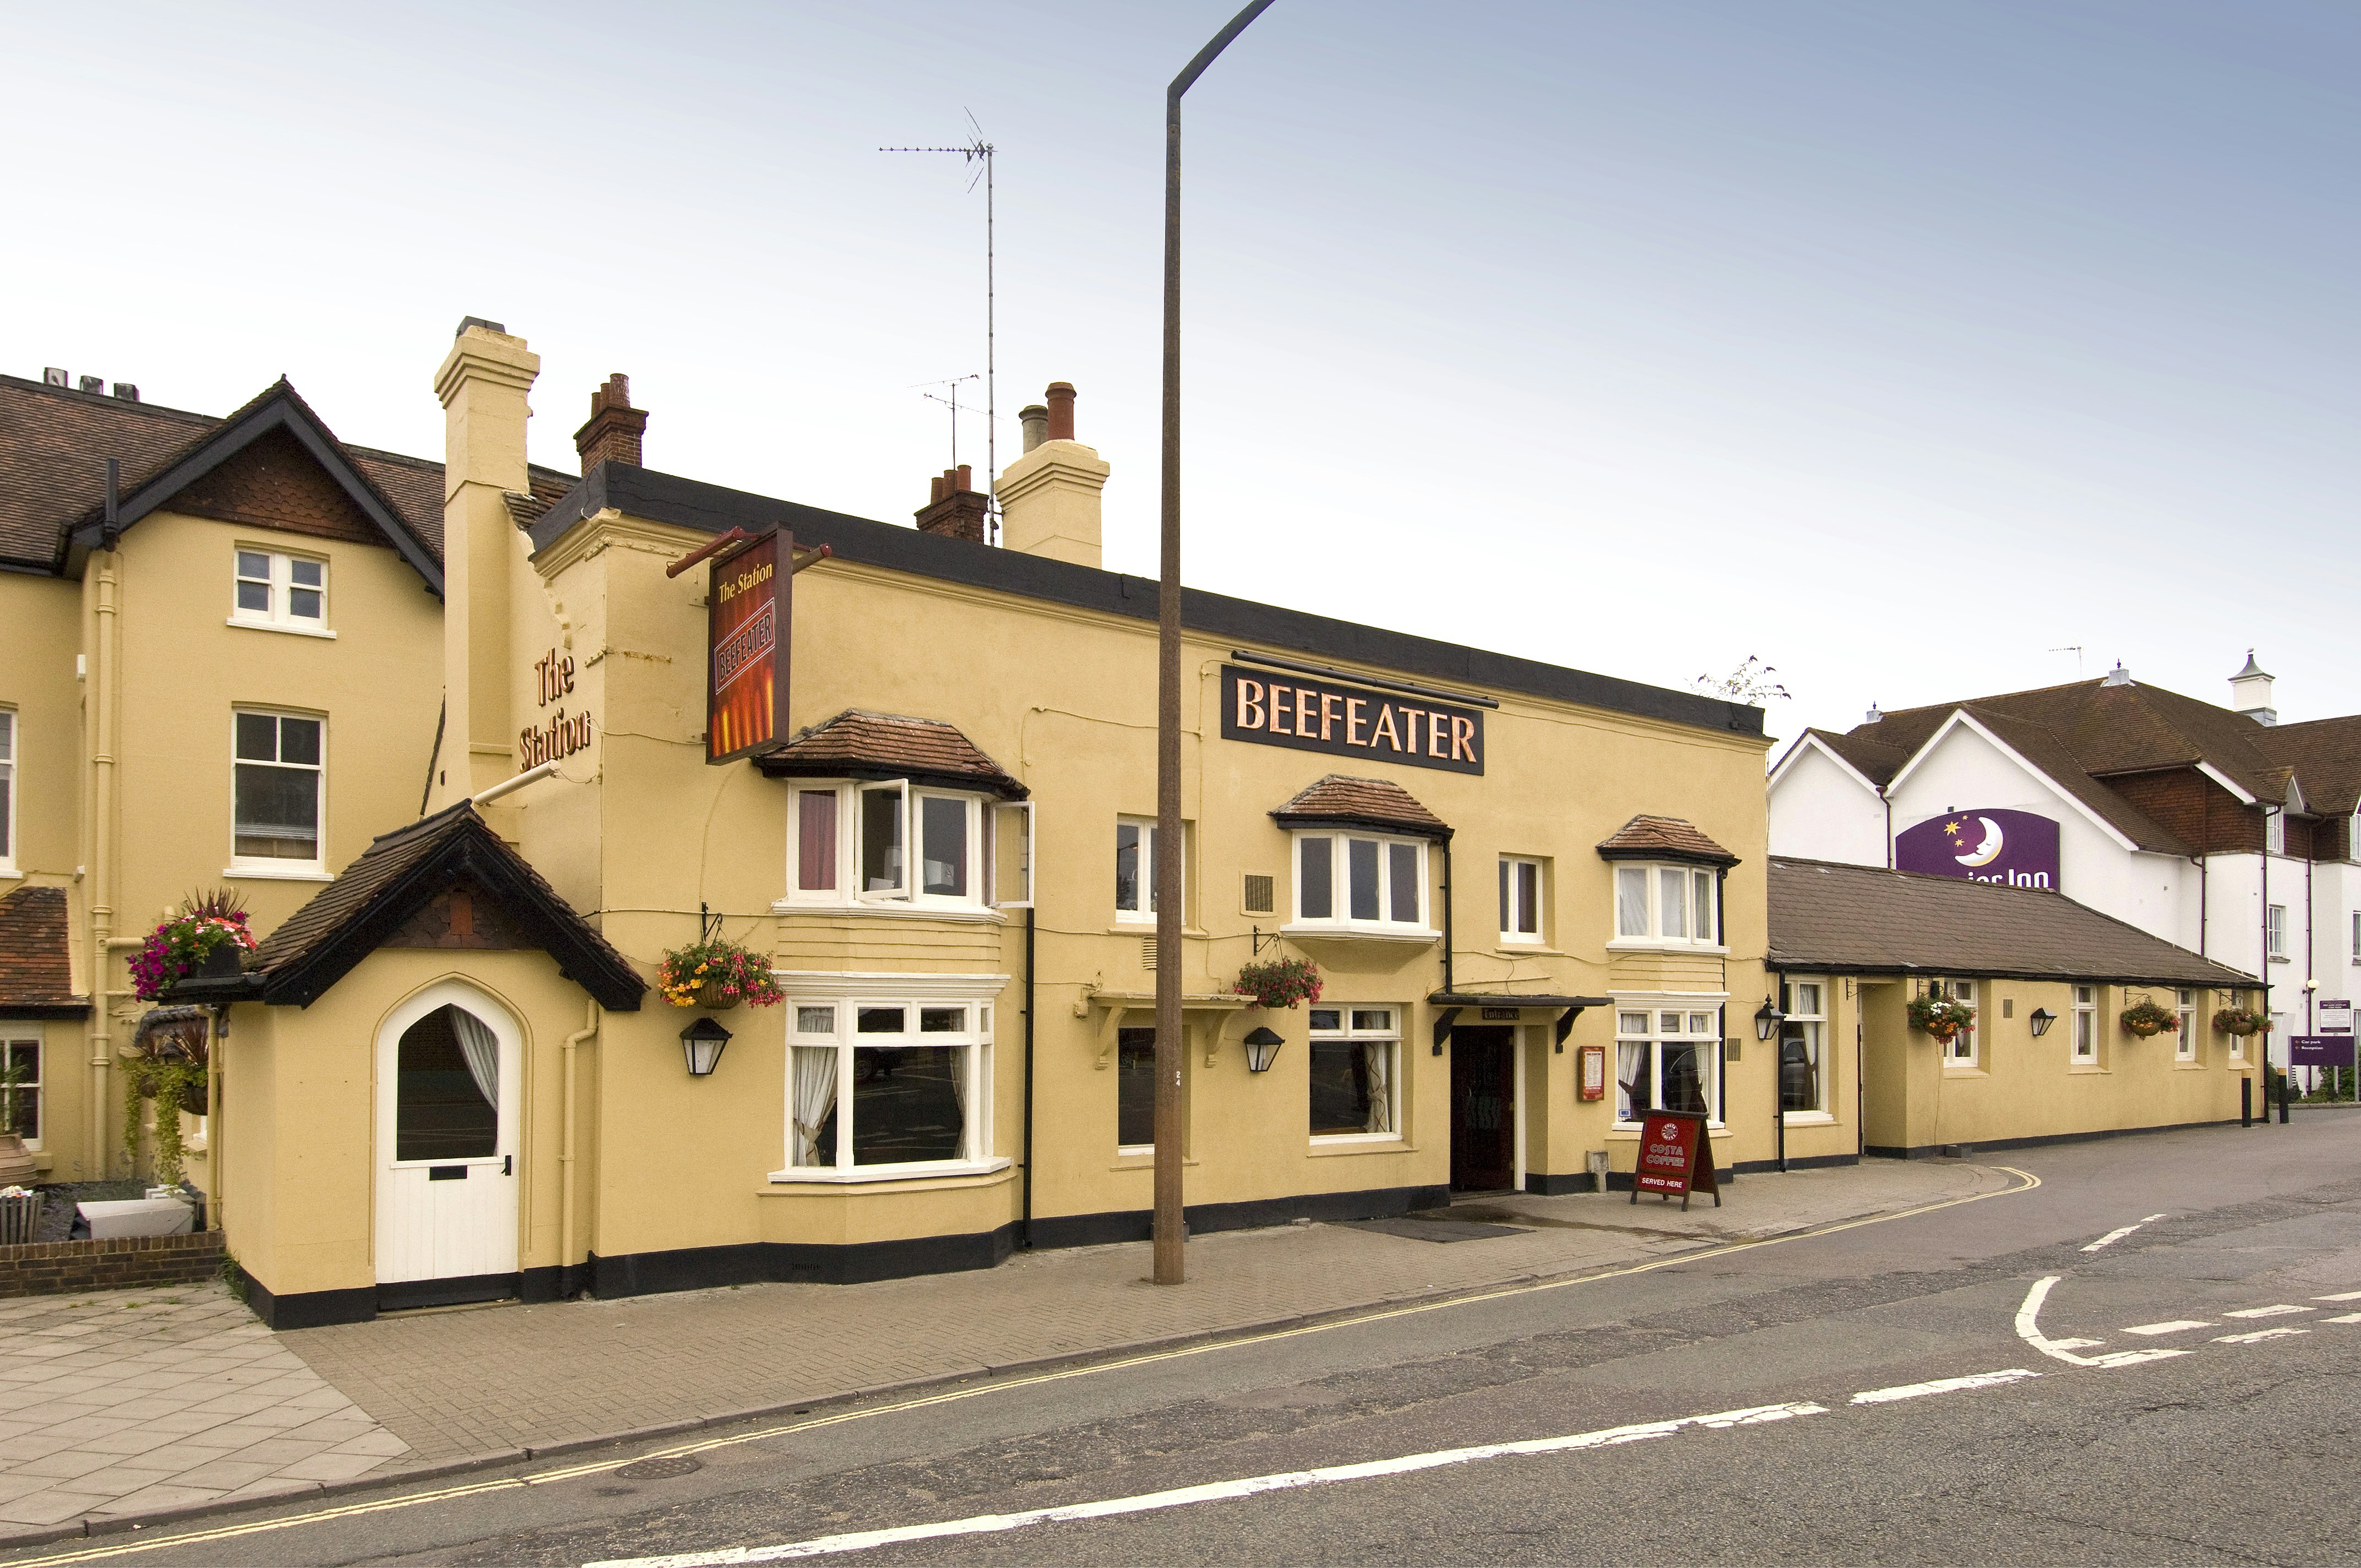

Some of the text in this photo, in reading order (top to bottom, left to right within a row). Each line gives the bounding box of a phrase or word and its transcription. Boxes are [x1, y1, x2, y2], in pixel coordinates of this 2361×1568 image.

[719, 563, 773, 603] The Station
[718, 613, 772, 682] BEEFEATER
[534, 647, 574, 707] The
[519, 707, 591, 774] Station
[1237, 678, 1477, 763] BEEFEATER
[2008, 869, 2049, 888] Inn
[1647, 1155, 1684, 1167] COFFEE
[1650, 1144, 1683, 1155] COSTA
[1642, 1177, 1665, 1186] SERVED
